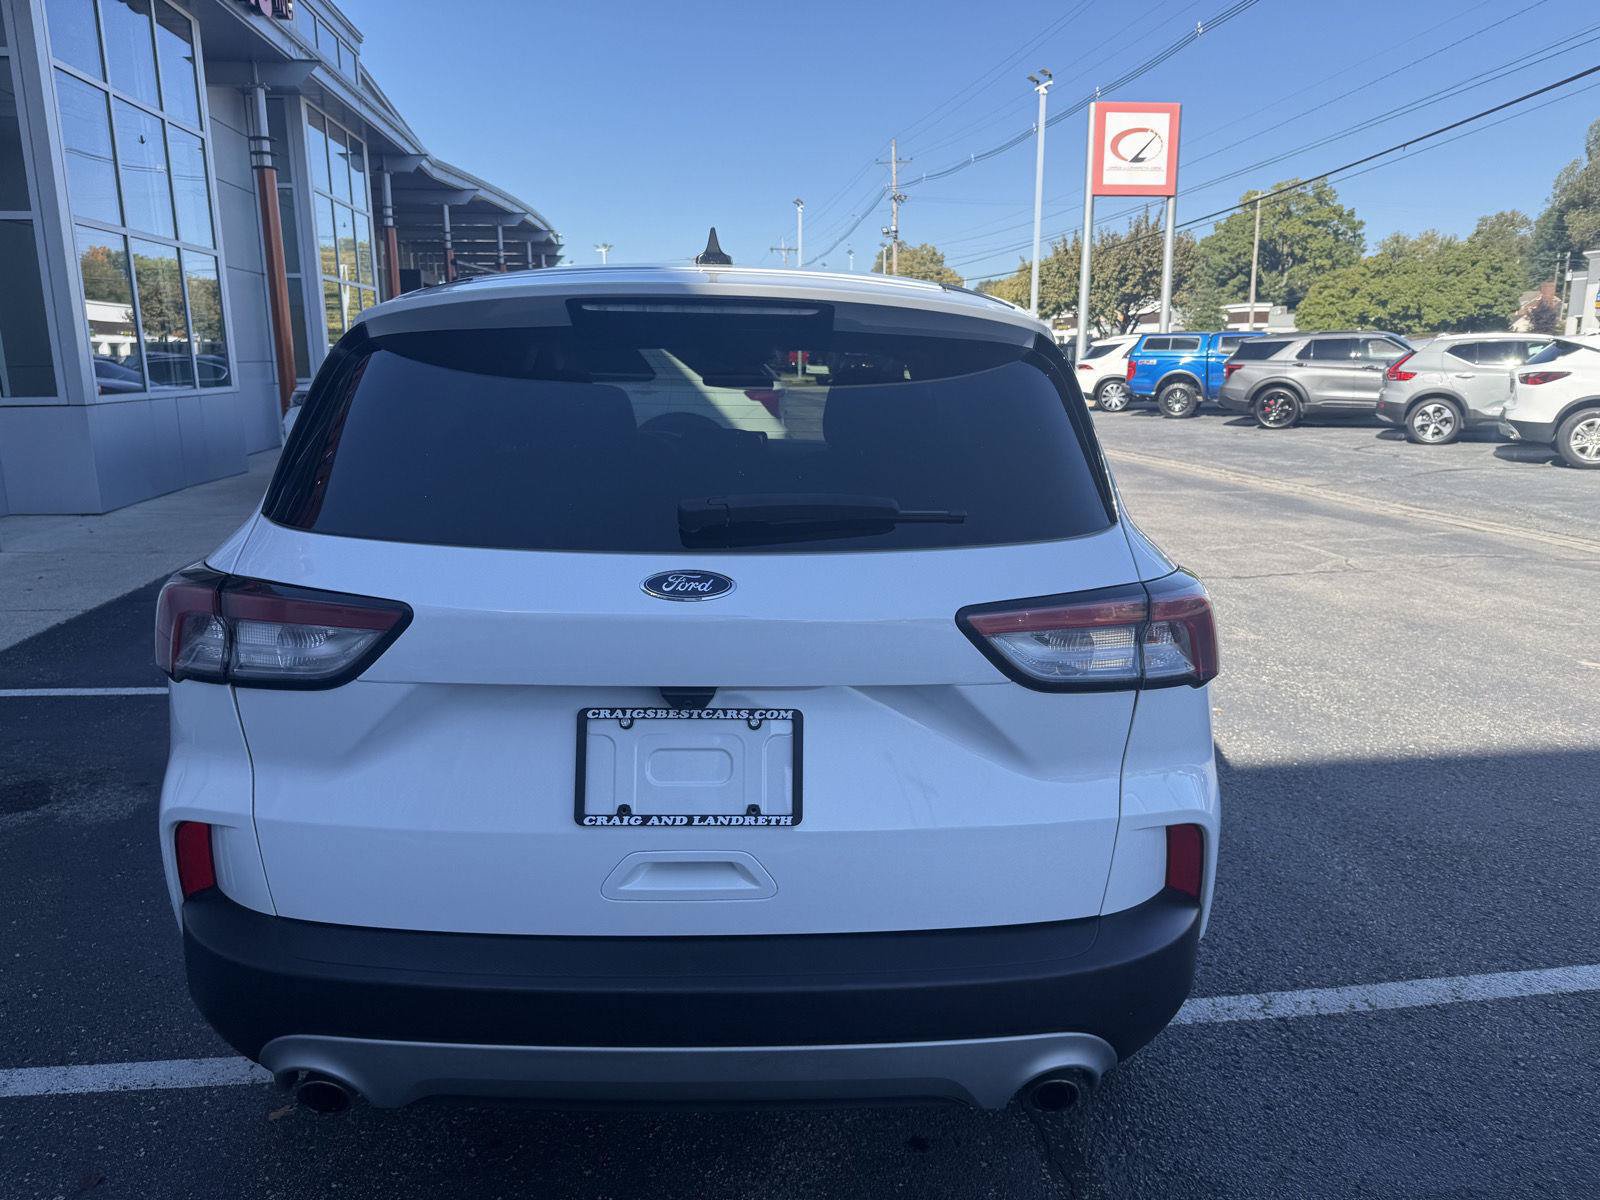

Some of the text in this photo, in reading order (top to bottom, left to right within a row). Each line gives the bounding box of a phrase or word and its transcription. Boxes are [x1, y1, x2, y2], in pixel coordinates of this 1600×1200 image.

[661, 574, 714, 592] Ford
[586, 709, 794, 719] CRAIGSBESTCARS.COM
[583, 815, 793, 826] CRAIG AND LANDRETH
